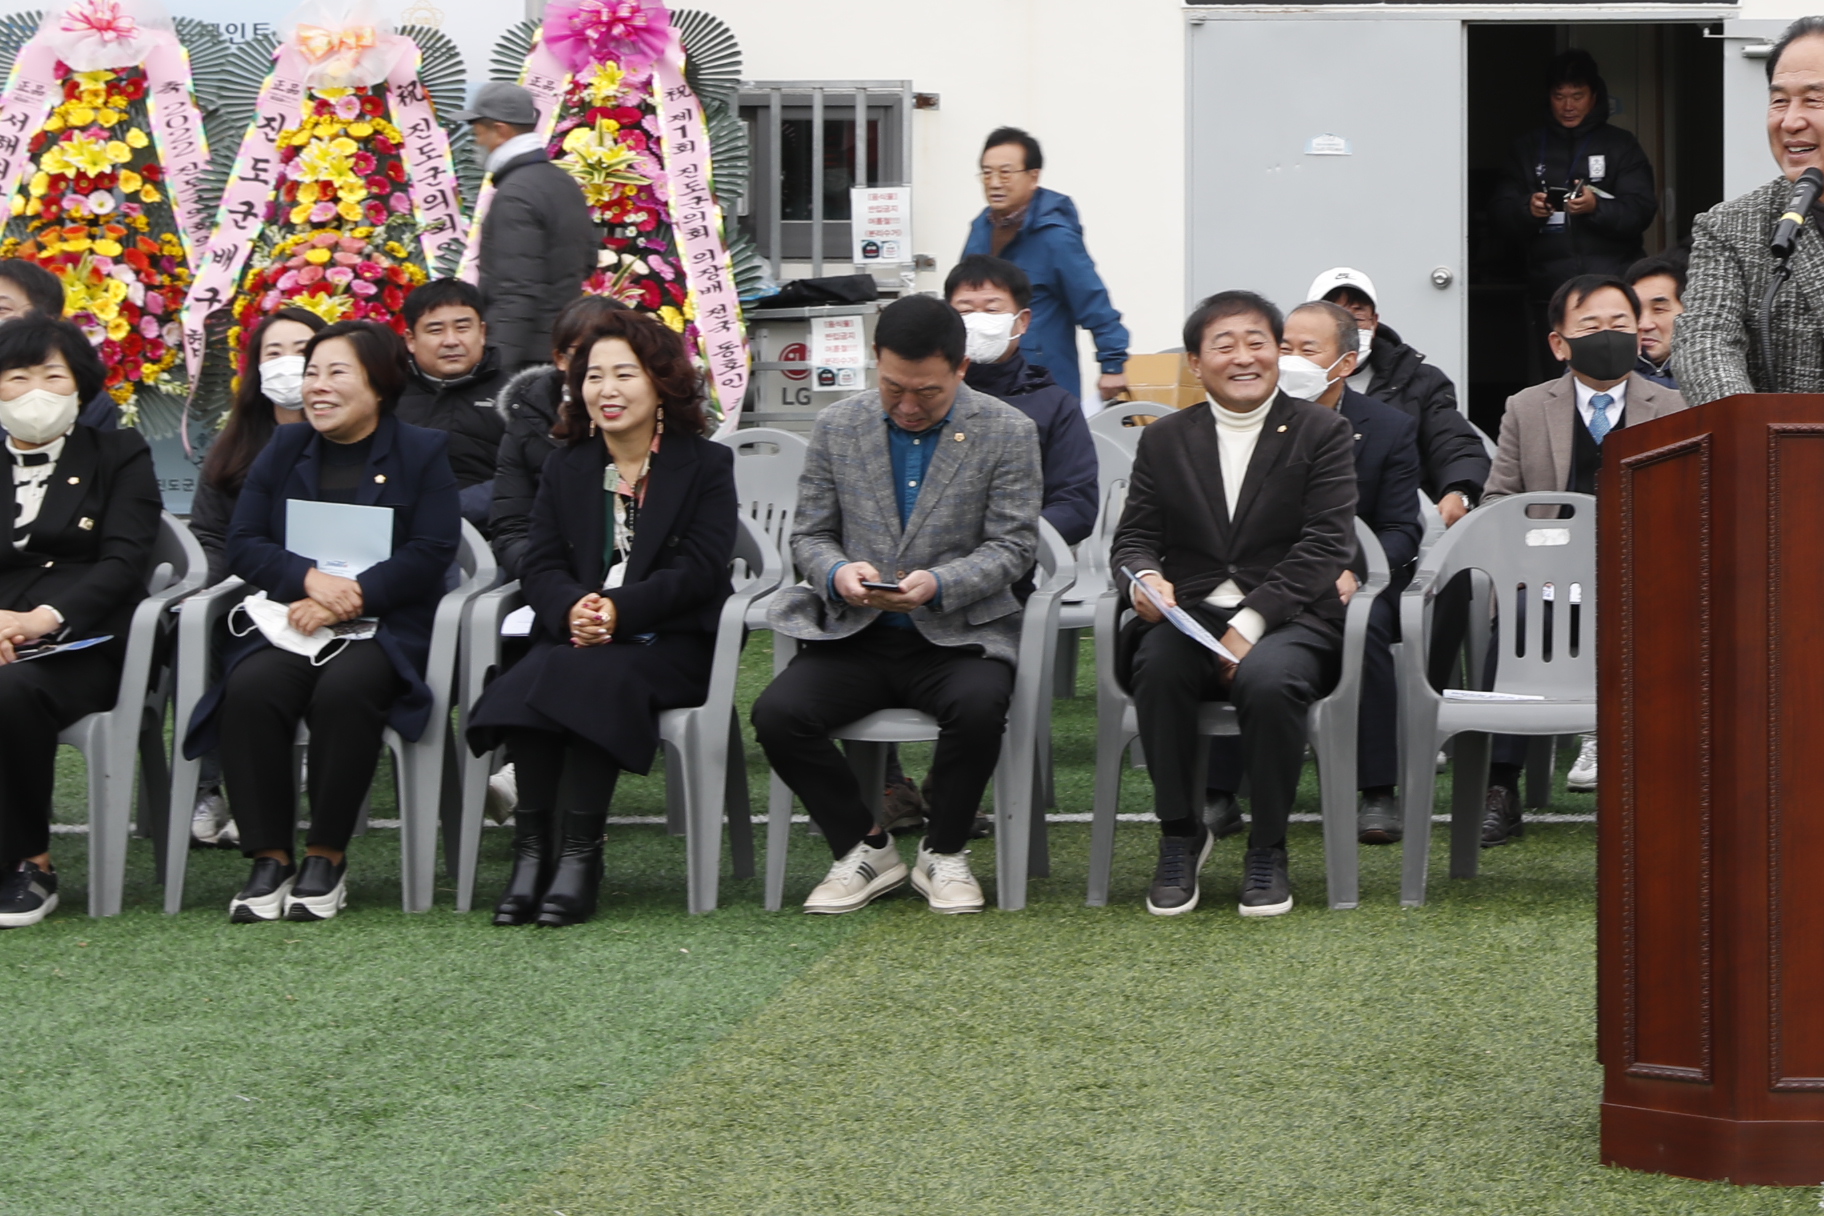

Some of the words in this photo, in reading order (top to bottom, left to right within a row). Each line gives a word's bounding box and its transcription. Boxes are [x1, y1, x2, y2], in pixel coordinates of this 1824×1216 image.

[397, 80, 426, 107] 祝
[664, 84, 693, 102] 祝
[163, 100, 196, 159] 2022
[668, 107, 696, 155] 제1회
[405, 117, 458, 235] 진도군의회
[674, 163, 710, 241] 진도군의회
[692, 248, 724, 296] 의장배
[705, 303, 736, 333] 전국
[712, 340, 746, 389] 동호인
[781, 386, 812, 406] LG
